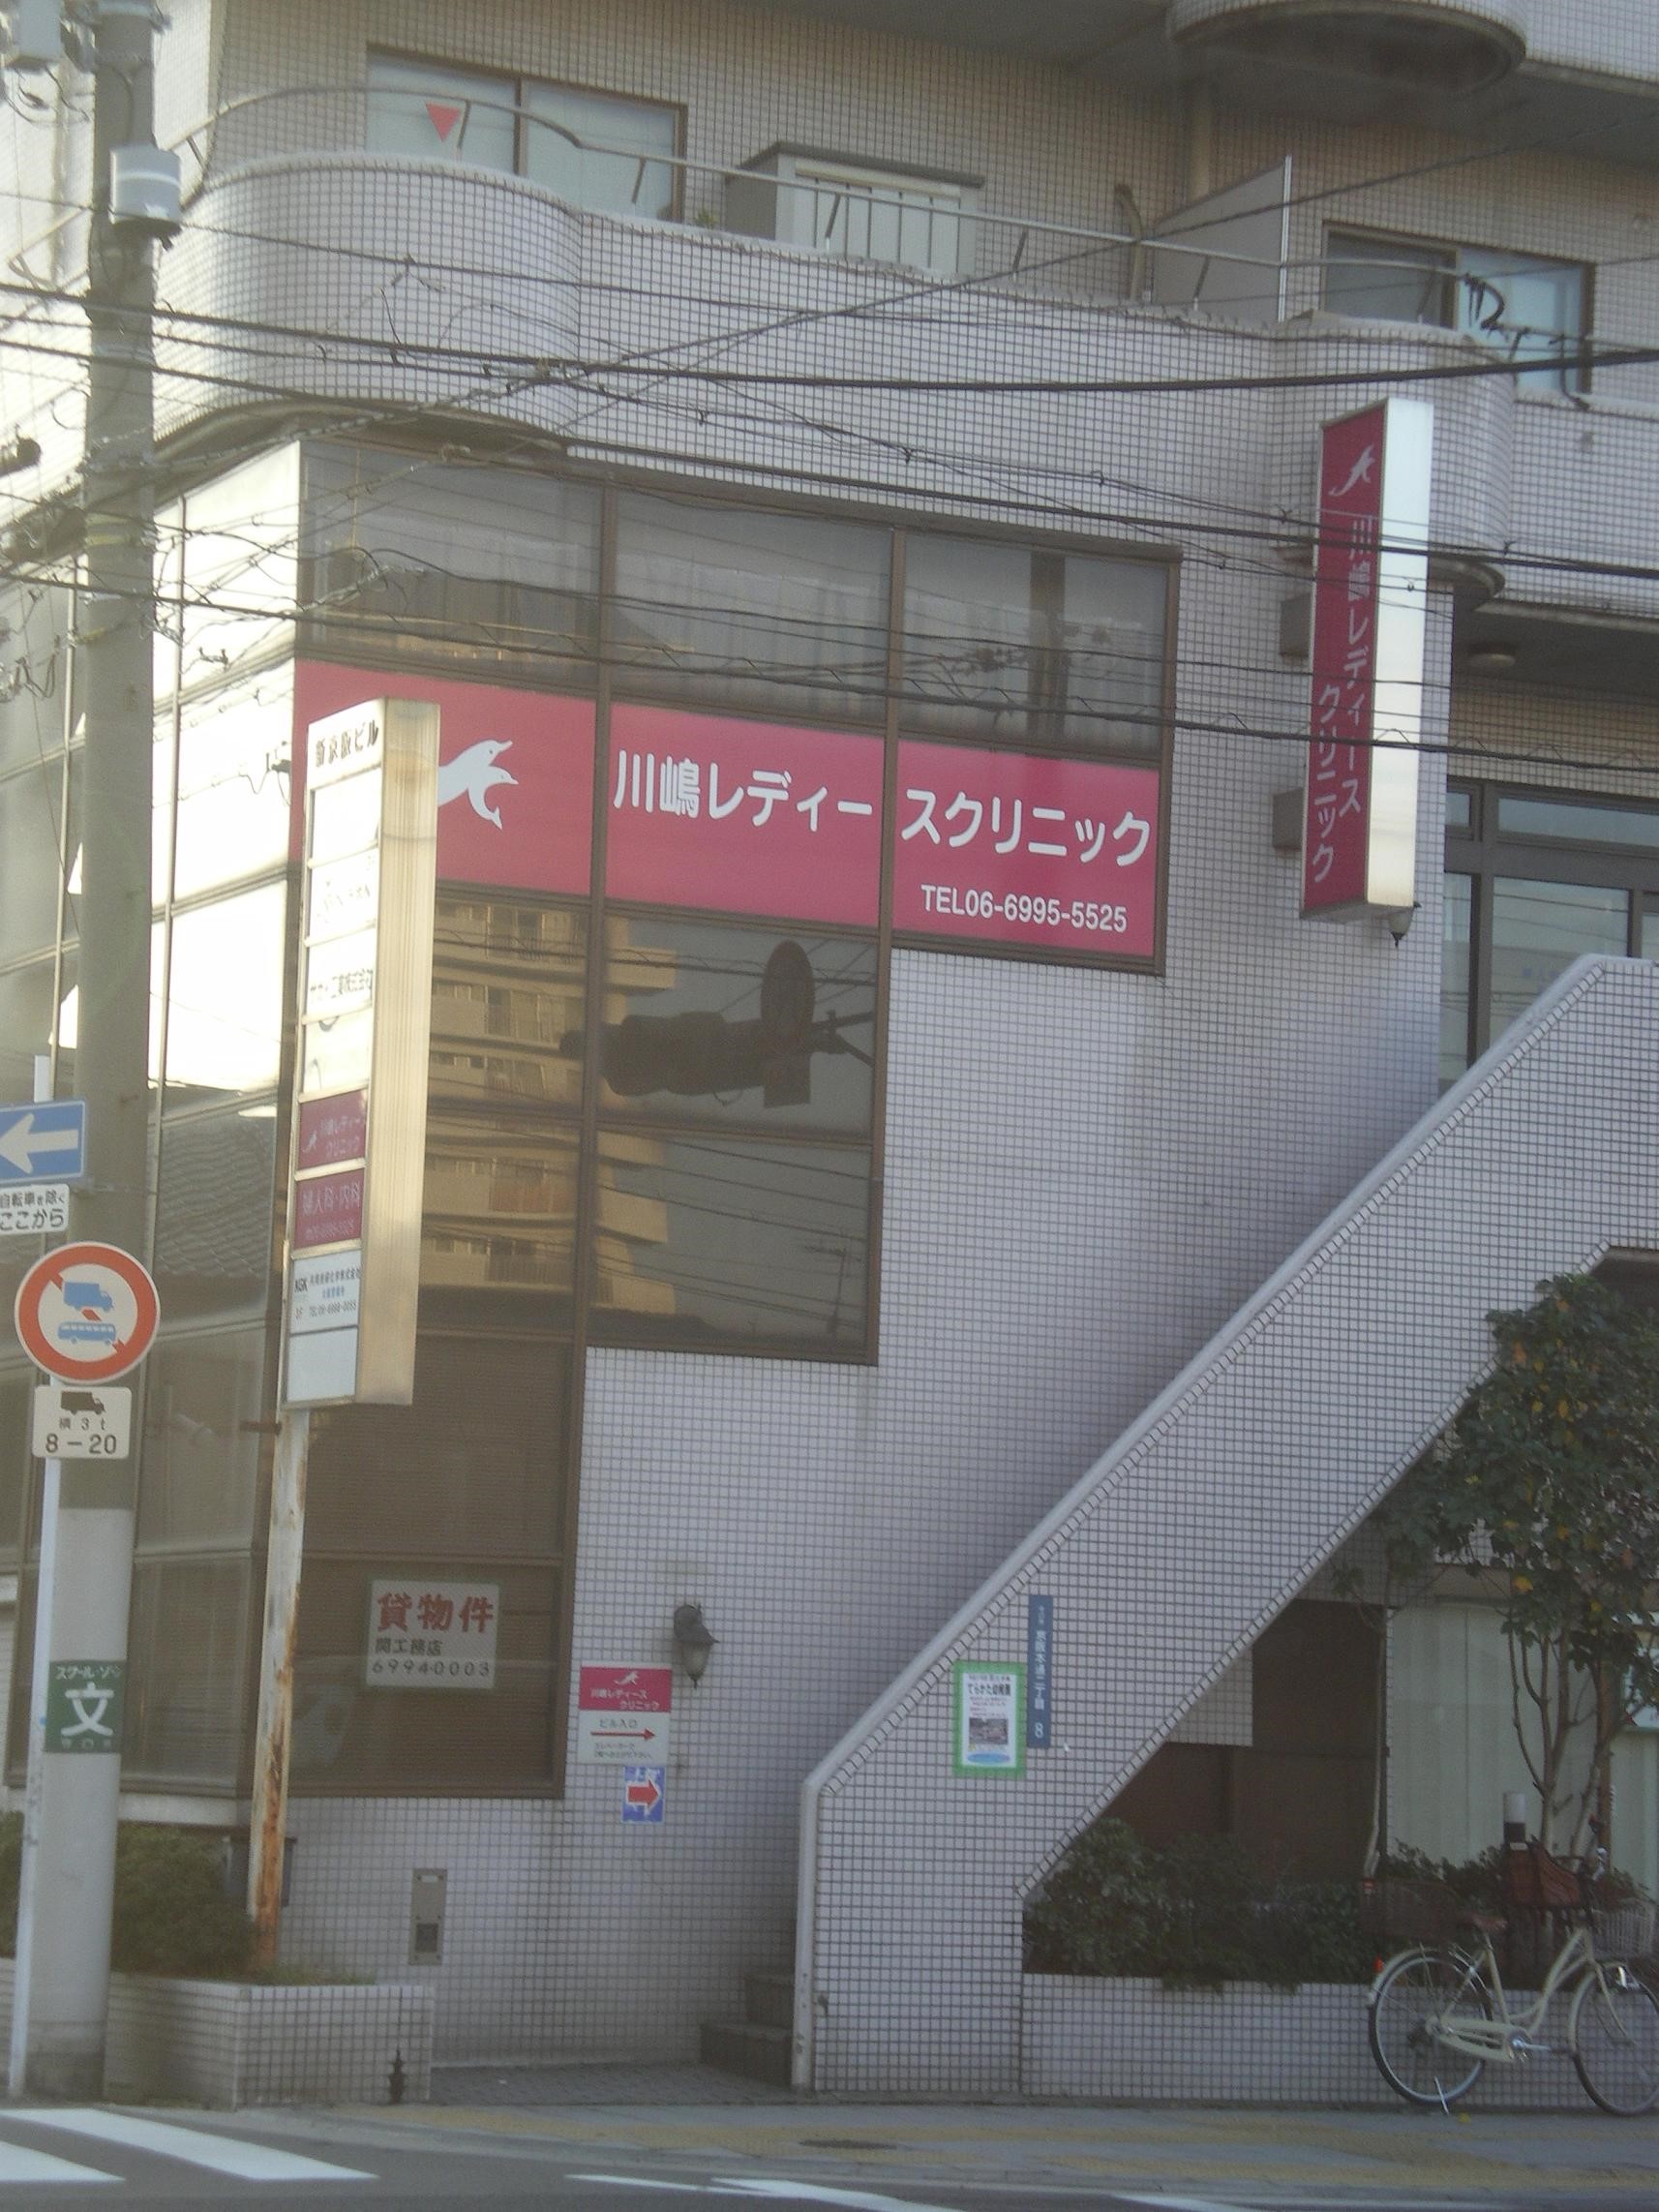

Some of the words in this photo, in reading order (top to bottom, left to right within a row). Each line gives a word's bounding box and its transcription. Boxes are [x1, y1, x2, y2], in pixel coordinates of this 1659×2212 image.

[1313, 682, 1340, 883] クリニック
[920, 883, 1129, 934] TEL06-6995-5525
[0, 1208, 65, 1231] ここから
[61, 1681, 115, 1737] 文
